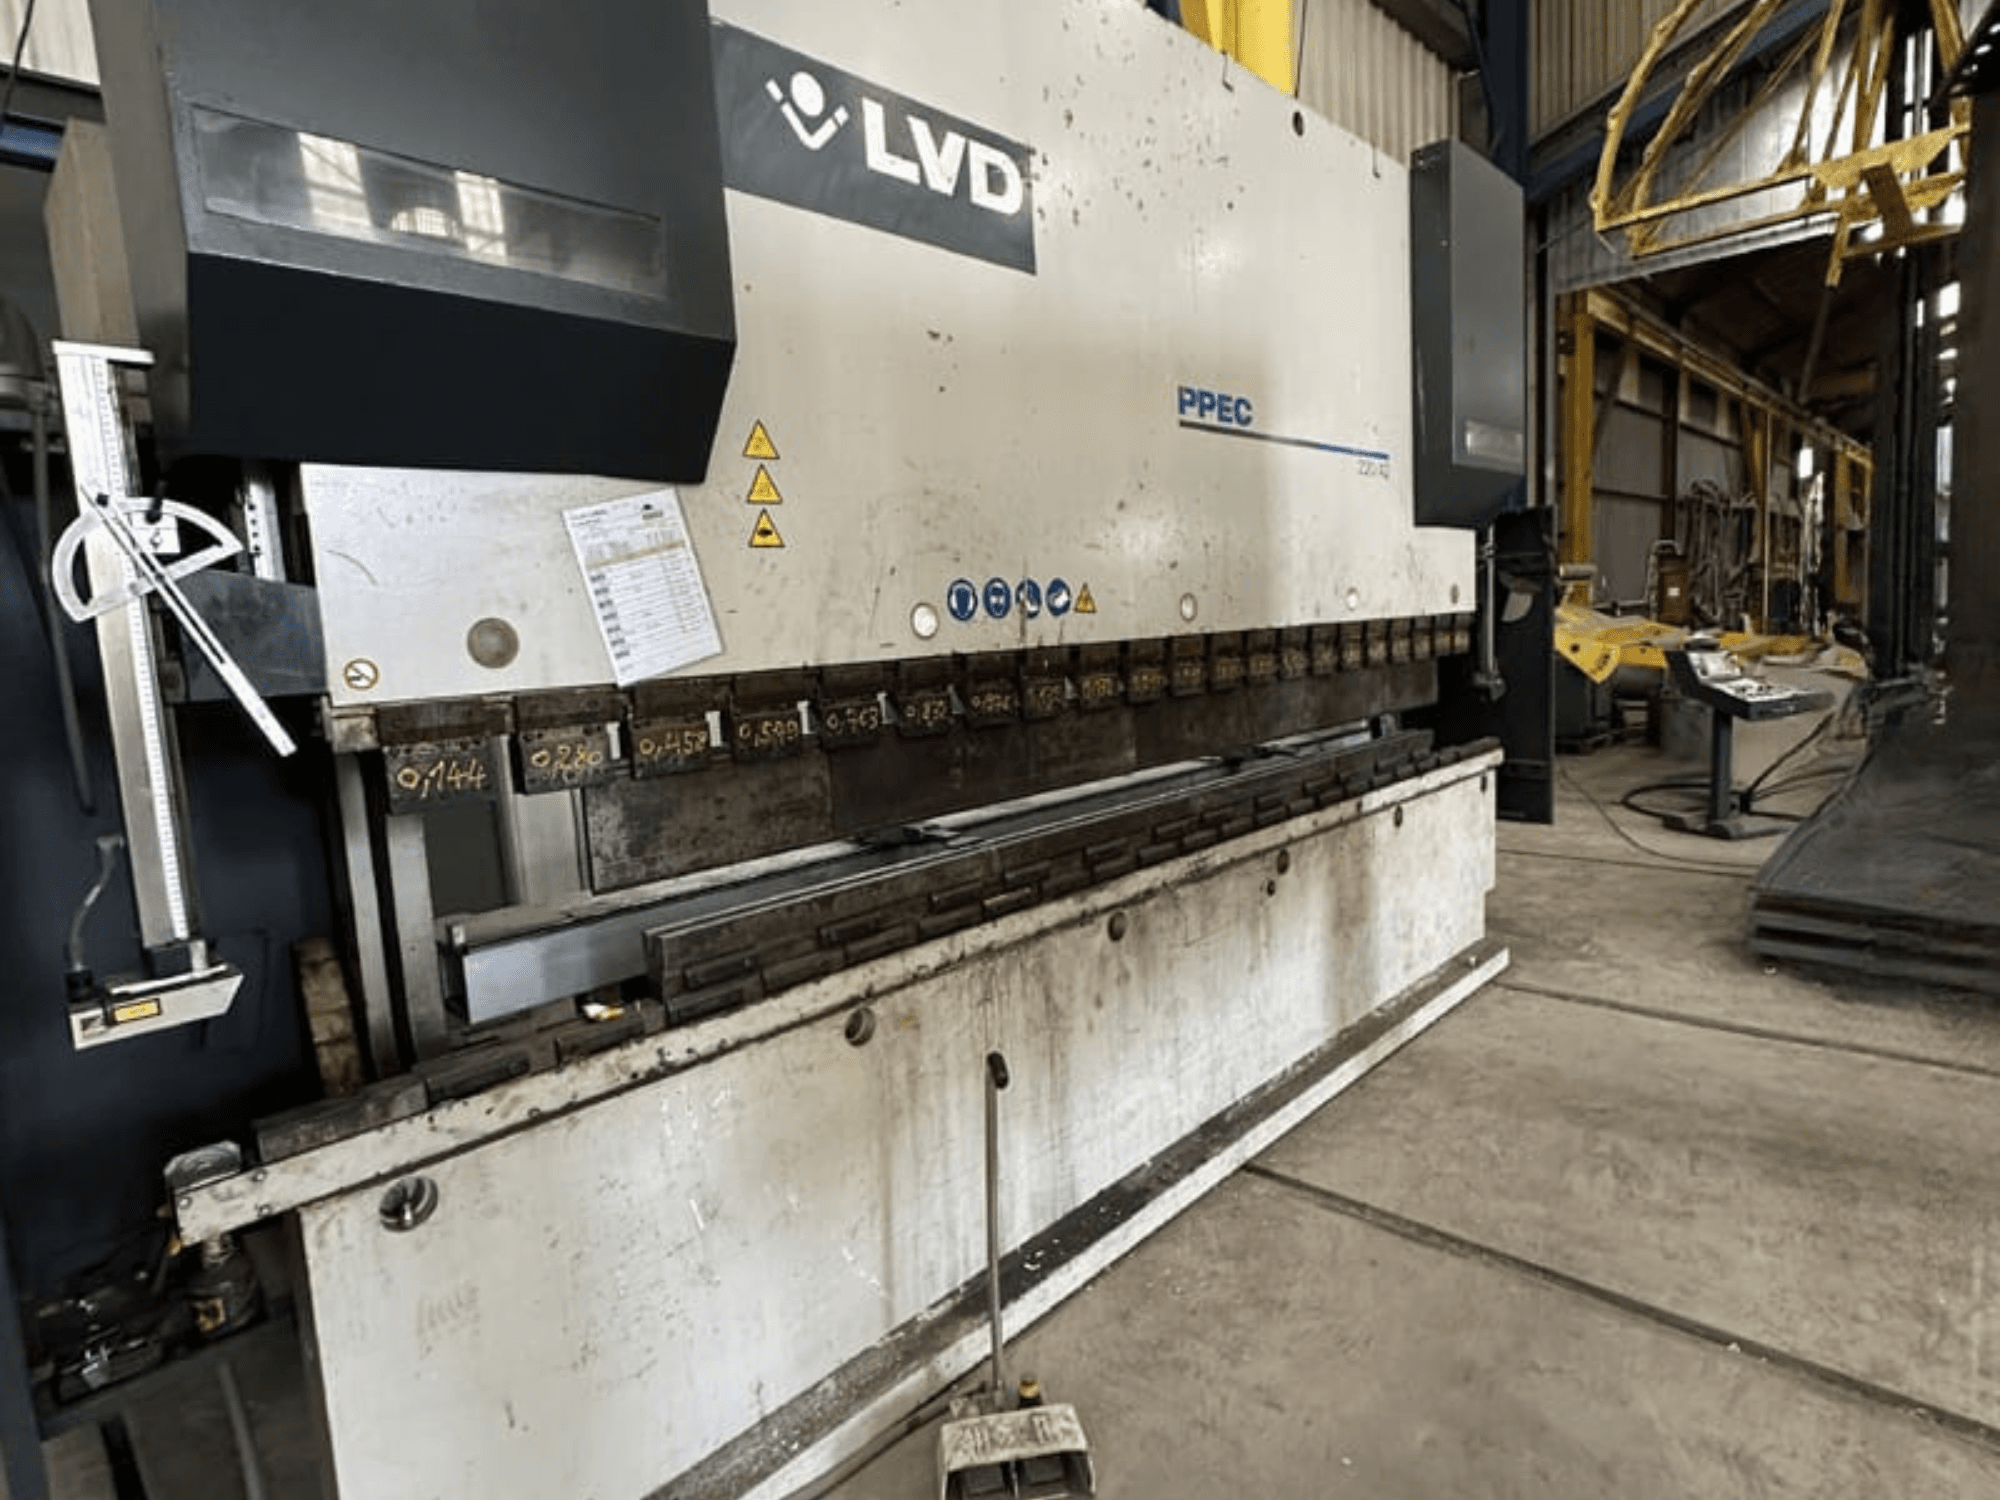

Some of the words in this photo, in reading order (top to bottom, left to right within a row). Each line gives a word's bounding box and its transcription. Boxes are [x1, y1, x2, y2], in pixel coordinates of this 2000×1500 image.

[862, 97, 1023, 215] LVD
[1178, 386, 1254, 427] PPEC
[396, 757, 487, 798] 0,144
